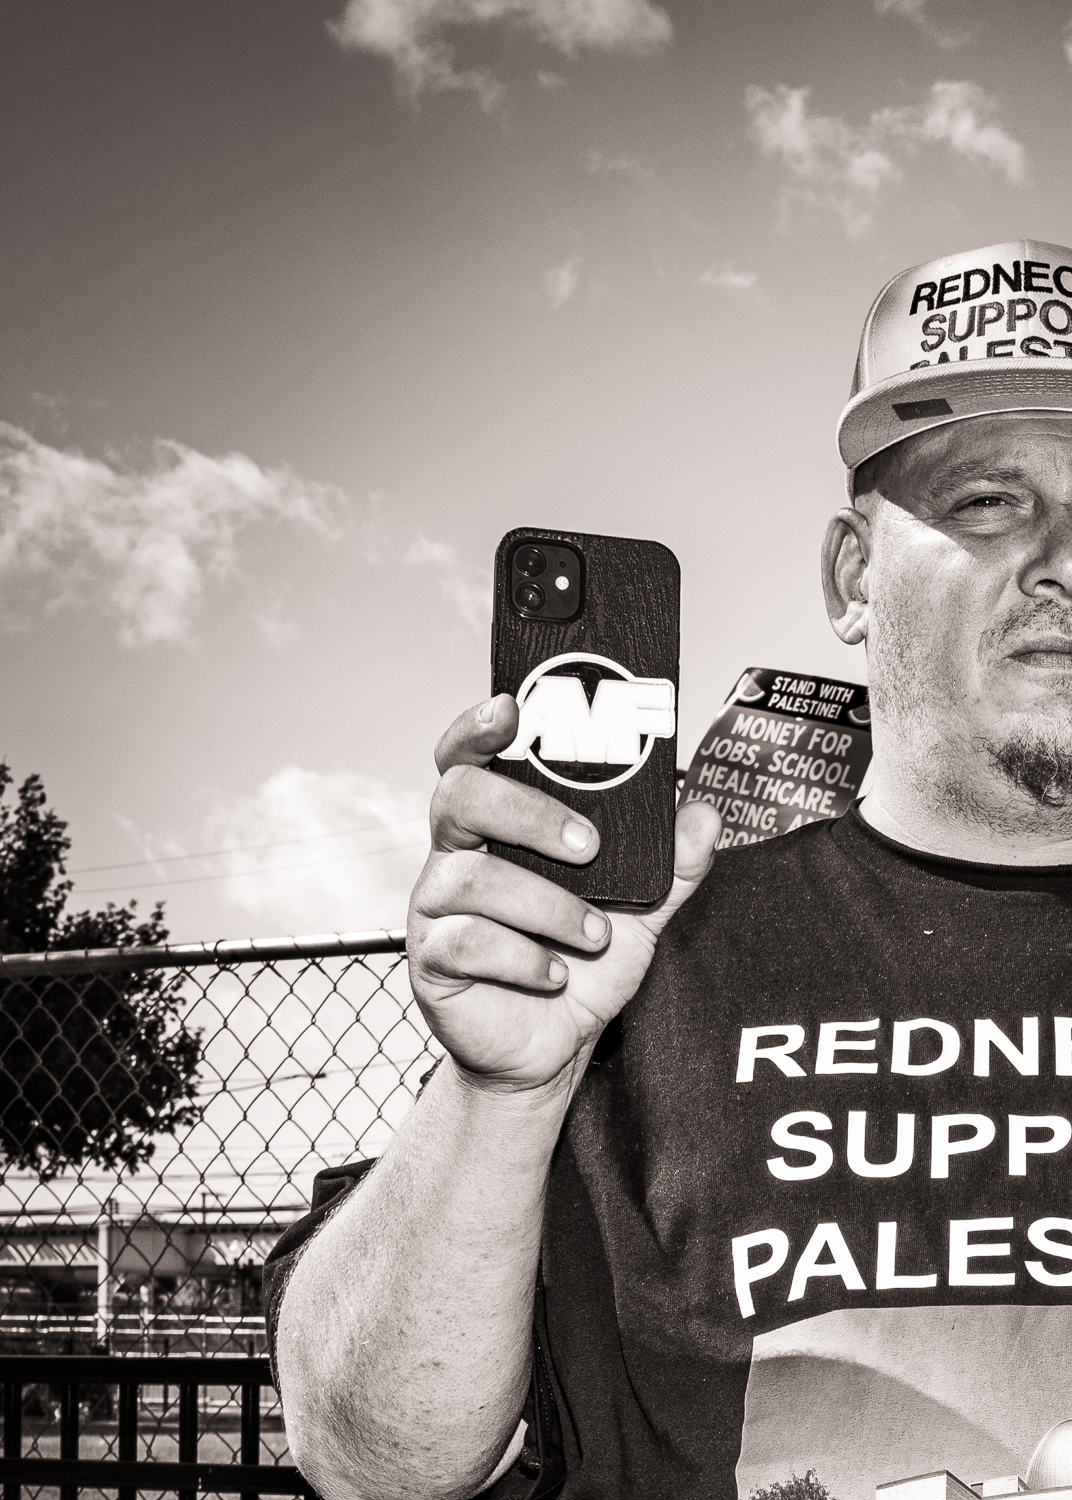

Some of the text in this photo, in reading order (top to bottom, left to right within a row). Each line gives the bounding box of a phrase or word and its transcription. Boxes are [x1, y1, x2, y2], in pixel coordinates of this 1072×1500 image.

[772, 676, 855, 703] STAND WITH
[767, 693, 842, 719] PALESTINE!
[730, 713, 853, 758] MONEY FOR
